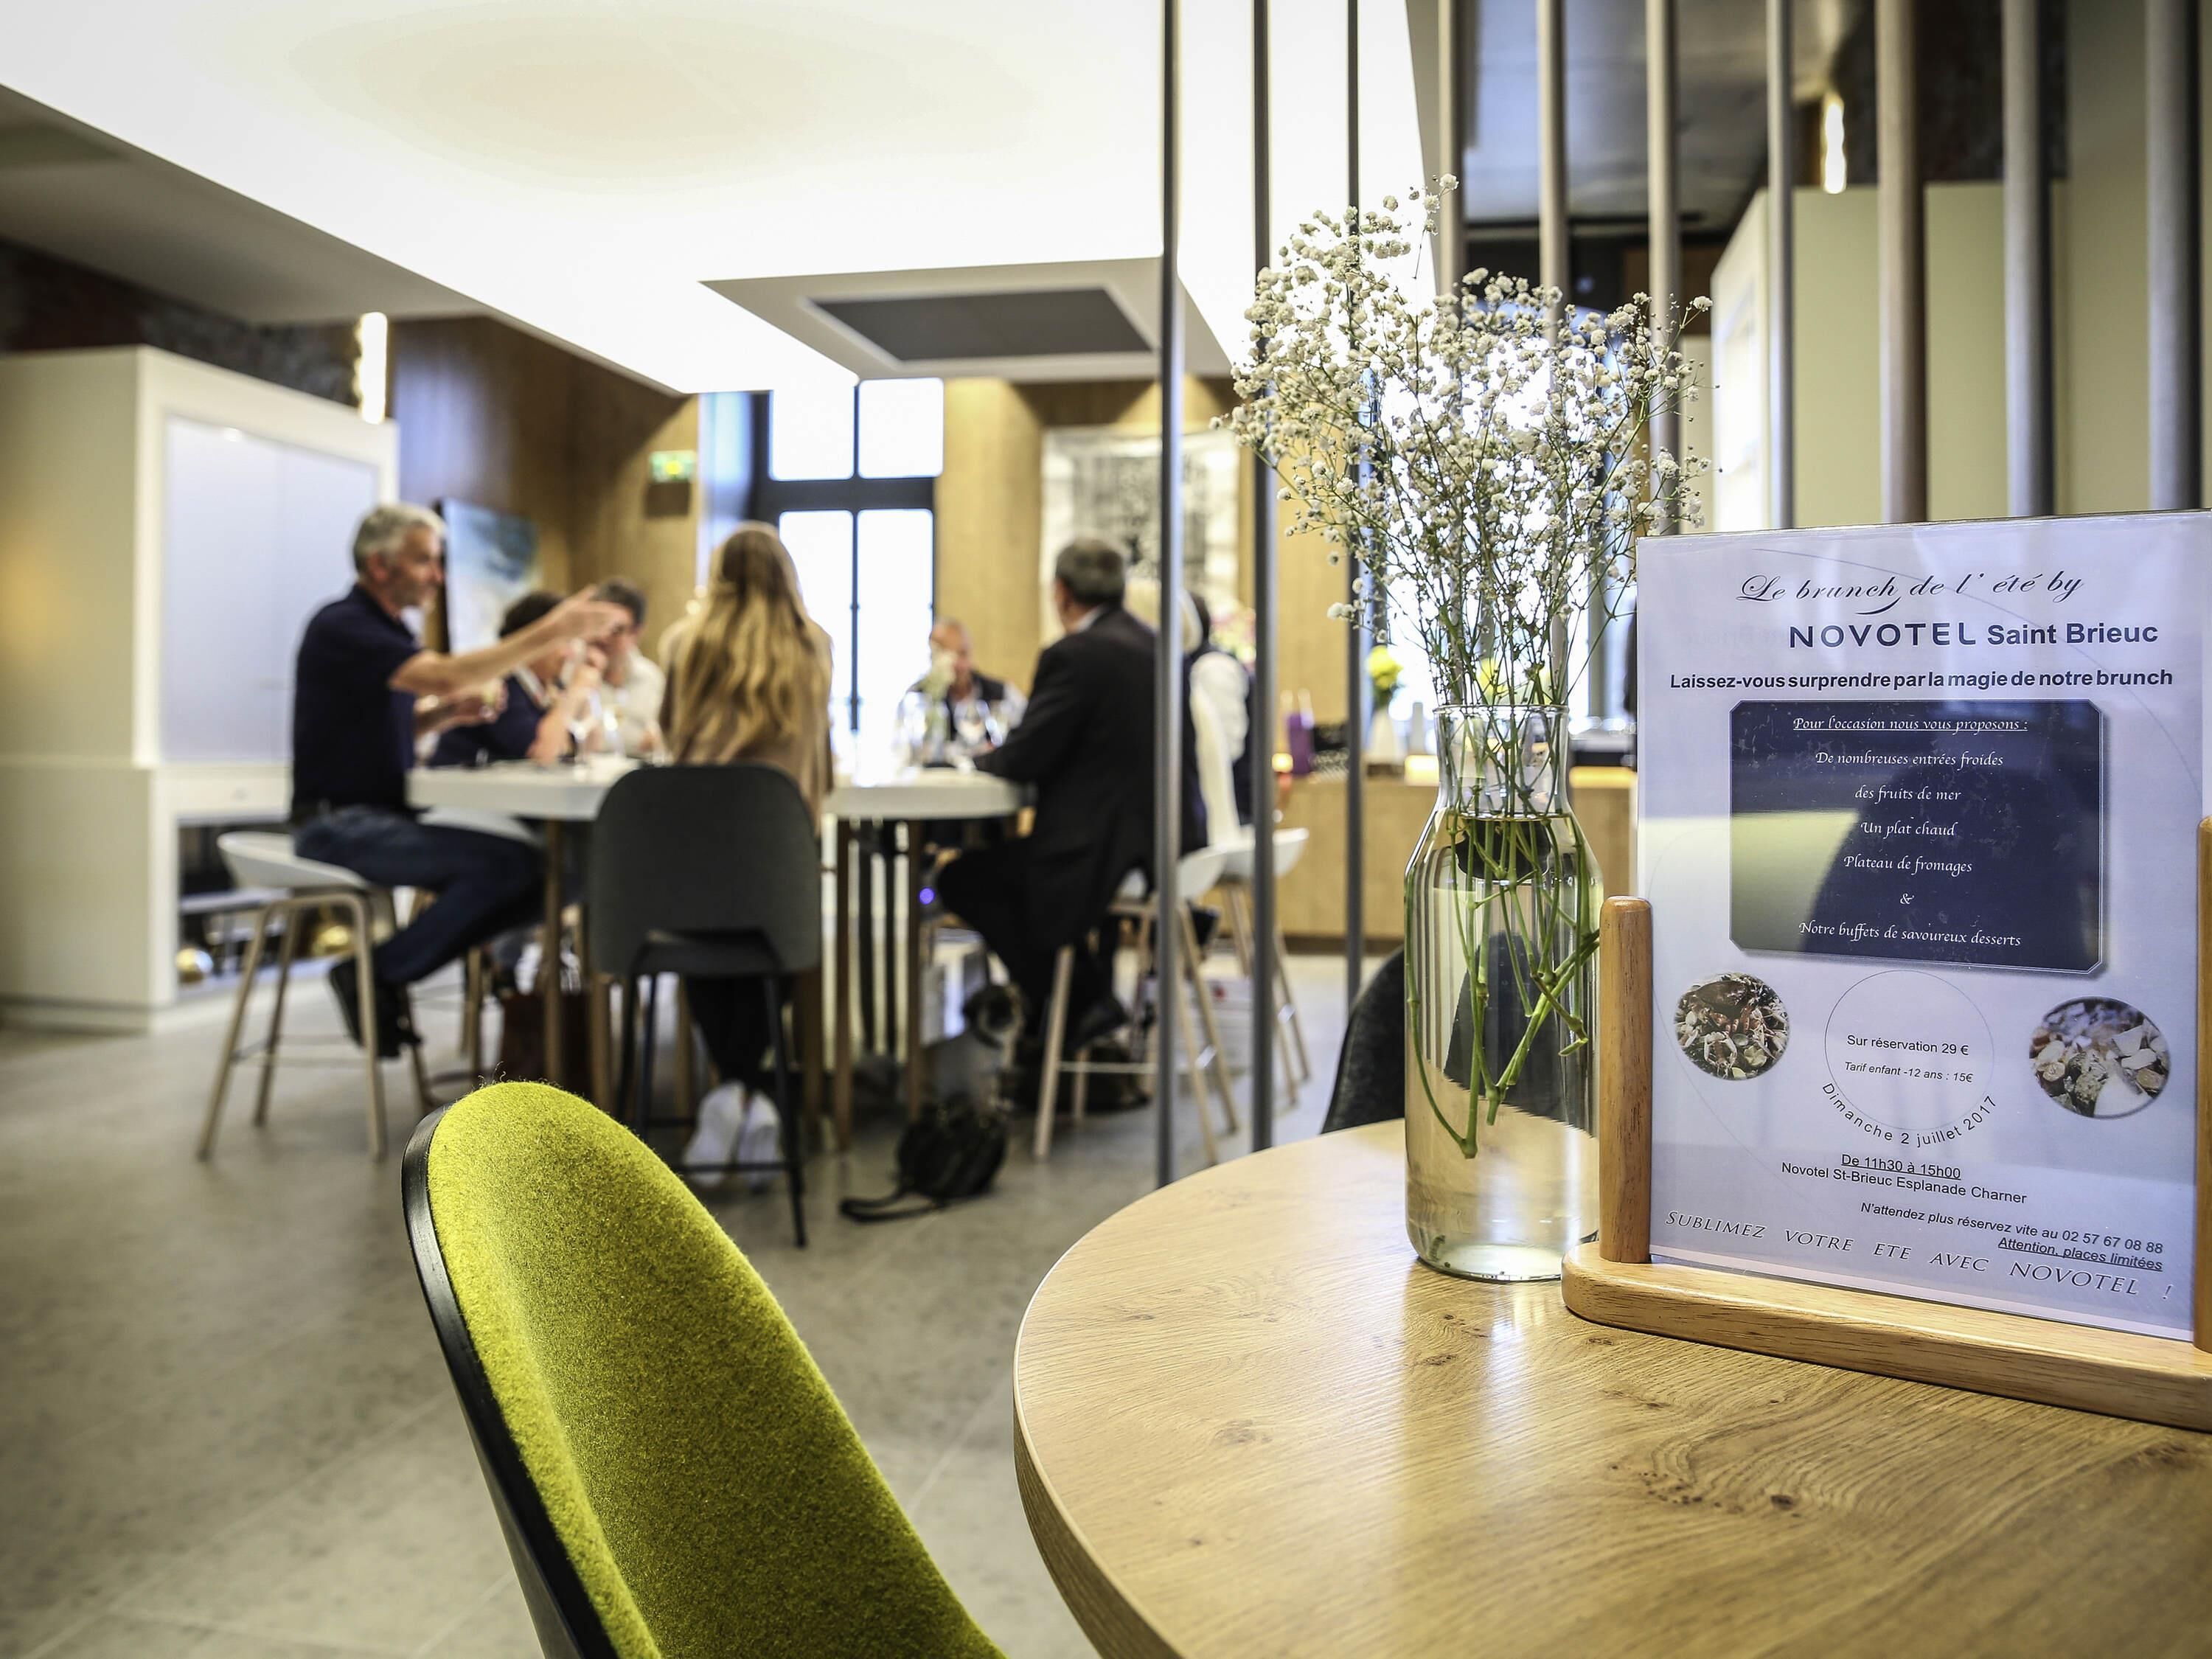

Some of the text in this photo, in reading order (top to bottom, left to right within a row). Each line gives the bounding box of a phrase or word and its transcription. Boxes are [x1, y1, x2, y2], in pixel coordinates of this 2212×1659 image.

[1736, 575, 1785, 602] Le
[1796, 577, 1897, 599] brunch
[1909, 576, 1944, 596] de
[1992, 574, 2042, 592] été
[2047, 571, 2084, 603] by
[1790, 622, 1976, 647] NOVOTEL
[1987, 624, 2056, 645] Saint
[2066, 622, 2158, 644] Brieuc
[1670, 669, 2172, 690] Laissez-vous surprendre par la magie de notre brunch
[1793, 717, 1825, 730] Pour
[1828, 715, 1885, 730] l'occasion
[1890, 720, 1919, 730] nous
[1923, 720, 1952, 730] vous
[1952, 720, 2020, 735] proposons
[1815, 750, 2003, 771] De nombreuses entrées froides
[1854, 785, 1961, 804] des fruits de mer
[1860, 821, 1958, 839] Un plat chaud
[1844, 854, 1972, 877] Plateau de fromages
[1899, 893, 1915, 905] &
[1798, 919, 2021, 946] Notre buffets de savoureux desserts
[1847, 1034, 1969, 1056] Sur réservation 29 €
[1845, 1062, 1865, 1072] Tarif
[1868, 1065, 1901, 1076] enfant
[1904, 1068, 1921, 1078] -12
[1924, 1071, 1943, 1079] ans
[1953, 1073, 1974, 1083] 15€
[1823, 1082, 1996, 1148] Dimanche 2 juillet 2017
[1842, 1154, 1961, 1179] De 11h30 à 15h00
[1781, 1161, 2026, 1204] Novotel St-Brieuc Esplanade Charner
[1861, 1203, 2163, 1254] N'attendez plus réservez vite au 02 57 67 08 88
[1785, 1229, 1854, 1251] VOTRE
[1874, 1242, 1912, 1260] ETE
[1929, 1252, 1989, 1272] AVEC
[2008, 1262, 2139, 1295] NOVOTEL
[2163, 1284, 2172, 1300] !
[2064, 1247, 2107, 1263] places
[2110, 1253, 2163, 1271] limitées
